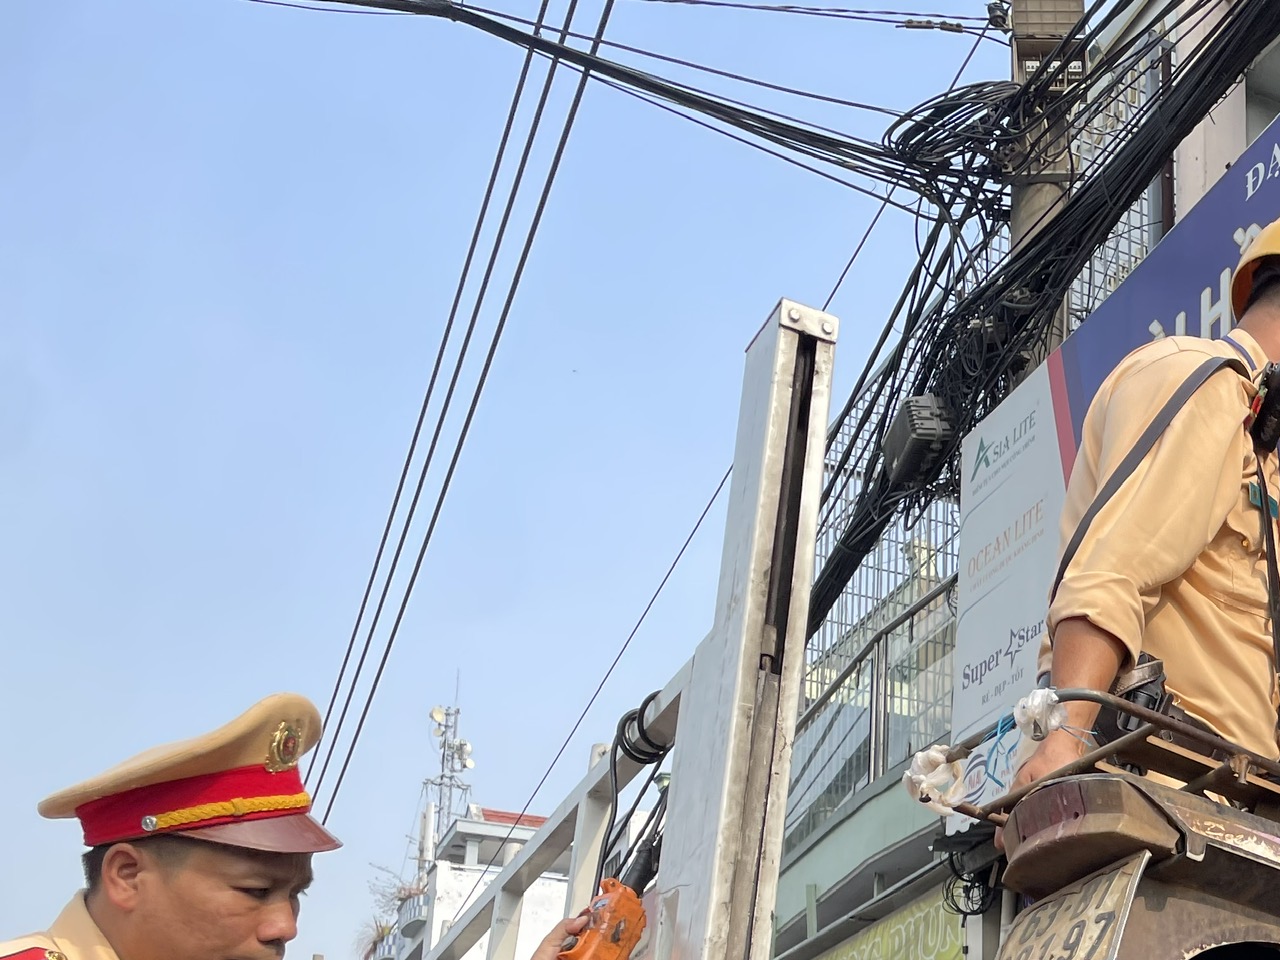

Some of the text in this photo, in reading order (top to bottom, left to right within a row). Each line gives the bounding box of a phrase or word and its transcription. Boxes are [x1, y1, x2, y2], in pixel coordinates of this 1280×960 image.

[970, 436, 1010, 483] ASIA
[1013, 410, 1036, 446] LITE
[968, 527, 1012, 578] OCEAN
[1015, 498, 1044, 542] LITE
[962, 619, 1045, 690] Super Star
